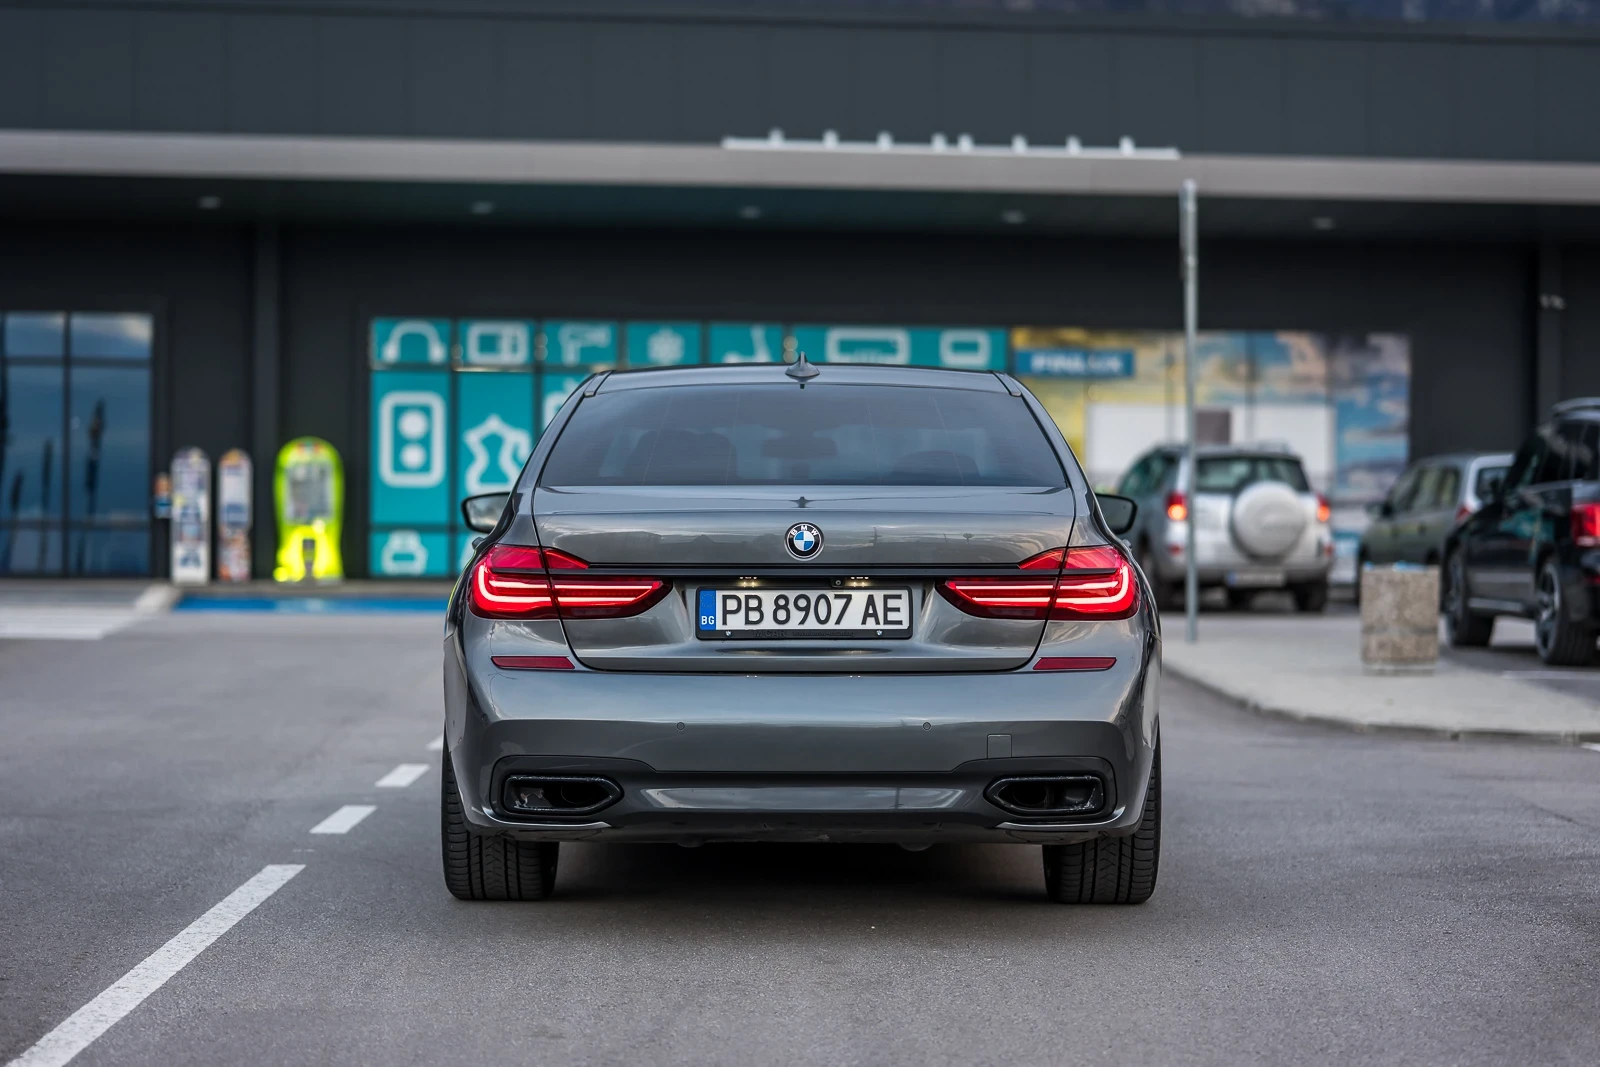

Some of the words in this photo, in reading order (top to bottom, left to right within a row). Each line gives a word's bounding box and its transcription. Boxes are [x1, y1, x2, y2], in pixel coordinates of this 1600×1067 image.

[790, 525, 819, 536] BMW
[722, 594, 764, 625] PB
[772, 594, 853, 625] 8907
[861, 594, 903, 625] AE
[701, 615, 715, 625] BG
